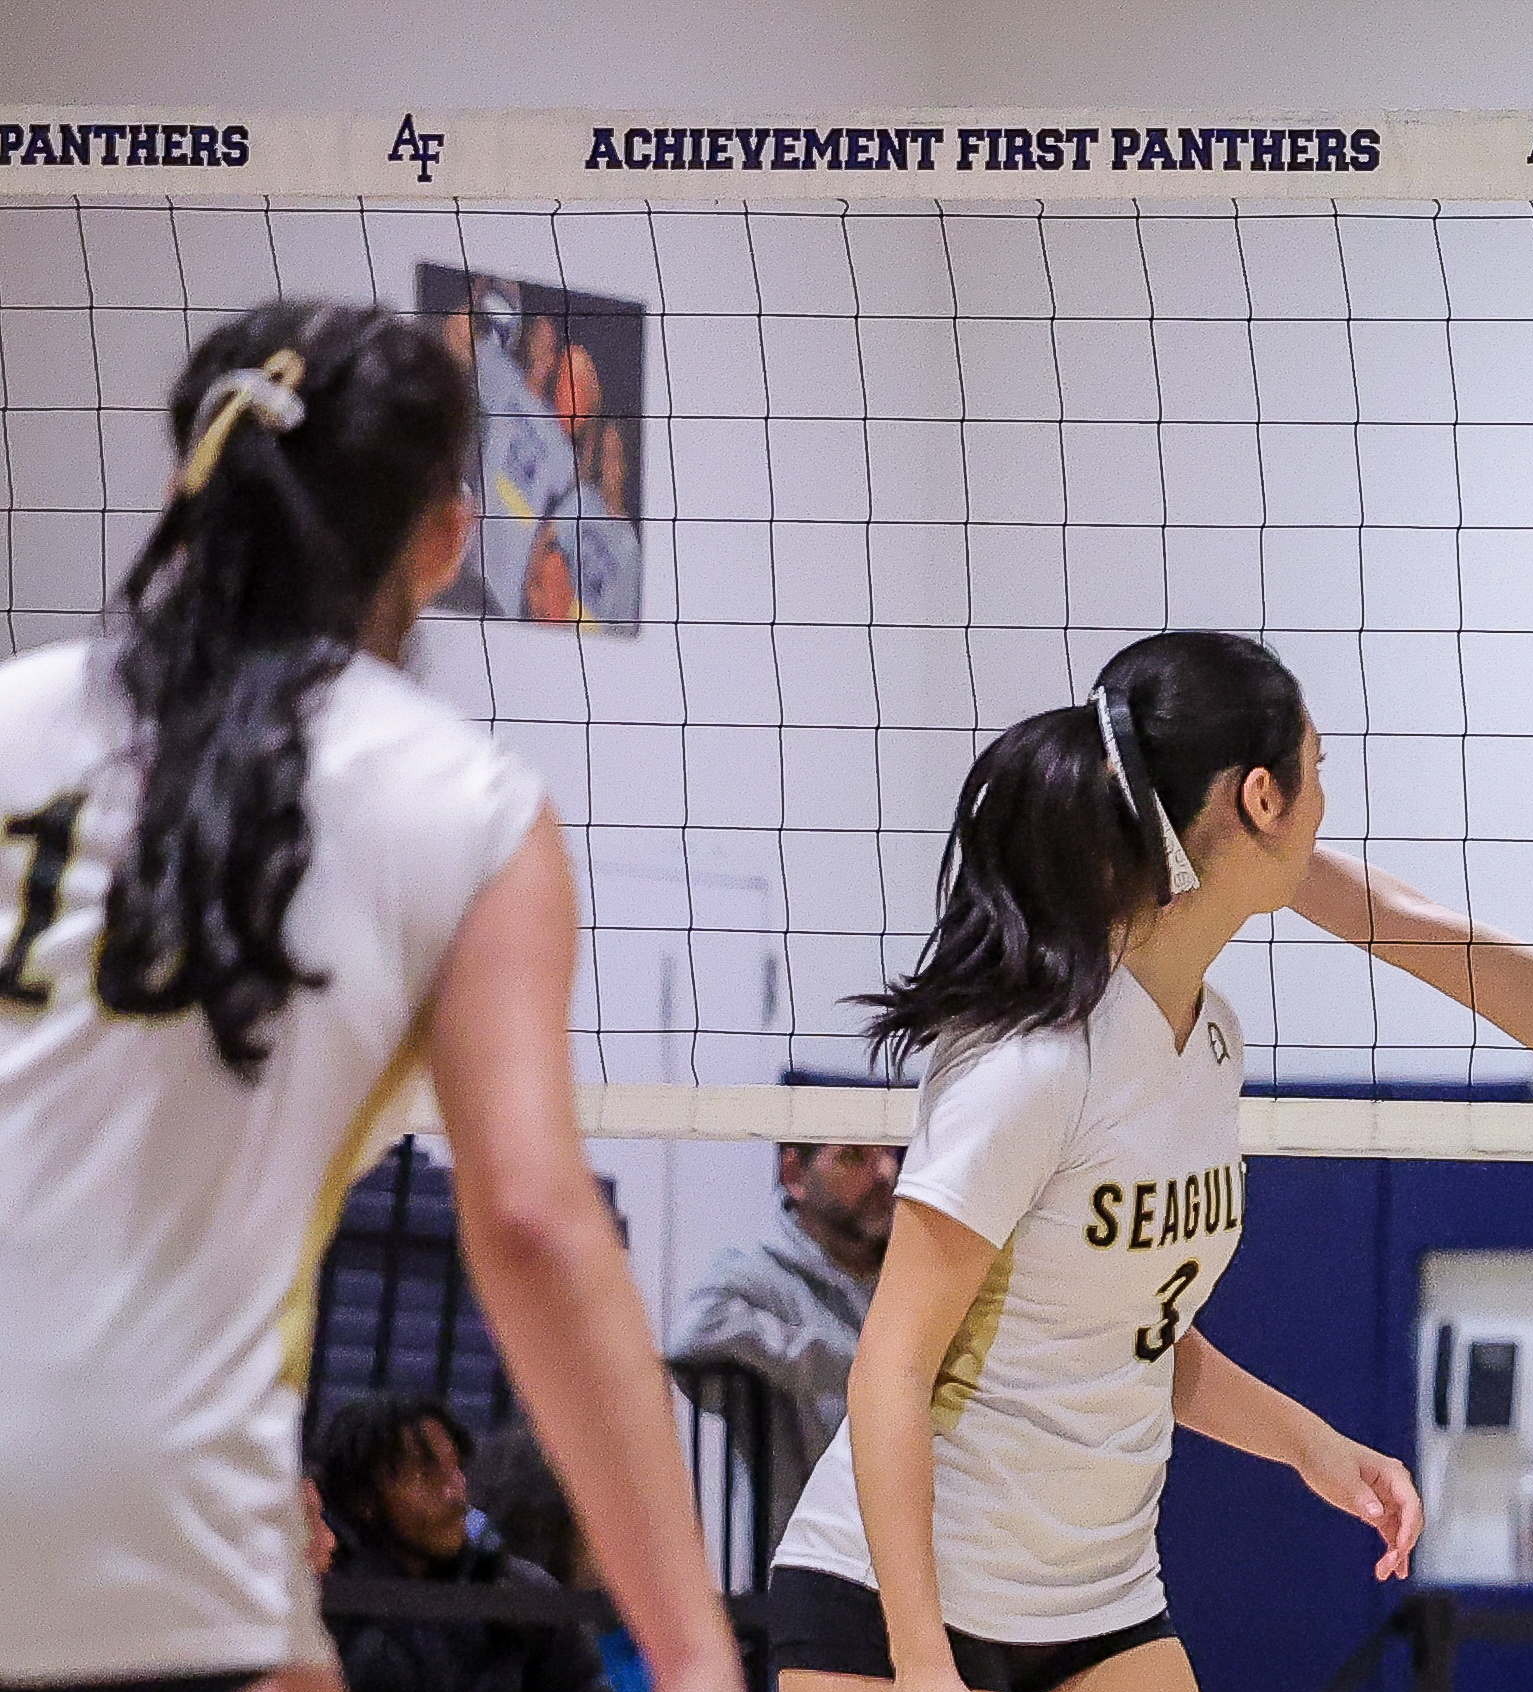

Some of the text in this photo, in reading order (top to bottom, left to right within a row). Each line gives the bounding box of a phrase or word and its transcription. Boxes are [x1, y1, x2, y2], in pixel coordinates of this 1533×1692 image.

[0, 124, 250, 167] PANTHERS
[388, 113, 445, 183] AF
[585, 127, 1380, 172] ACHIEVEMENT FIRST PANTHERS
[1136, 1259, 1201, 1364] 3
